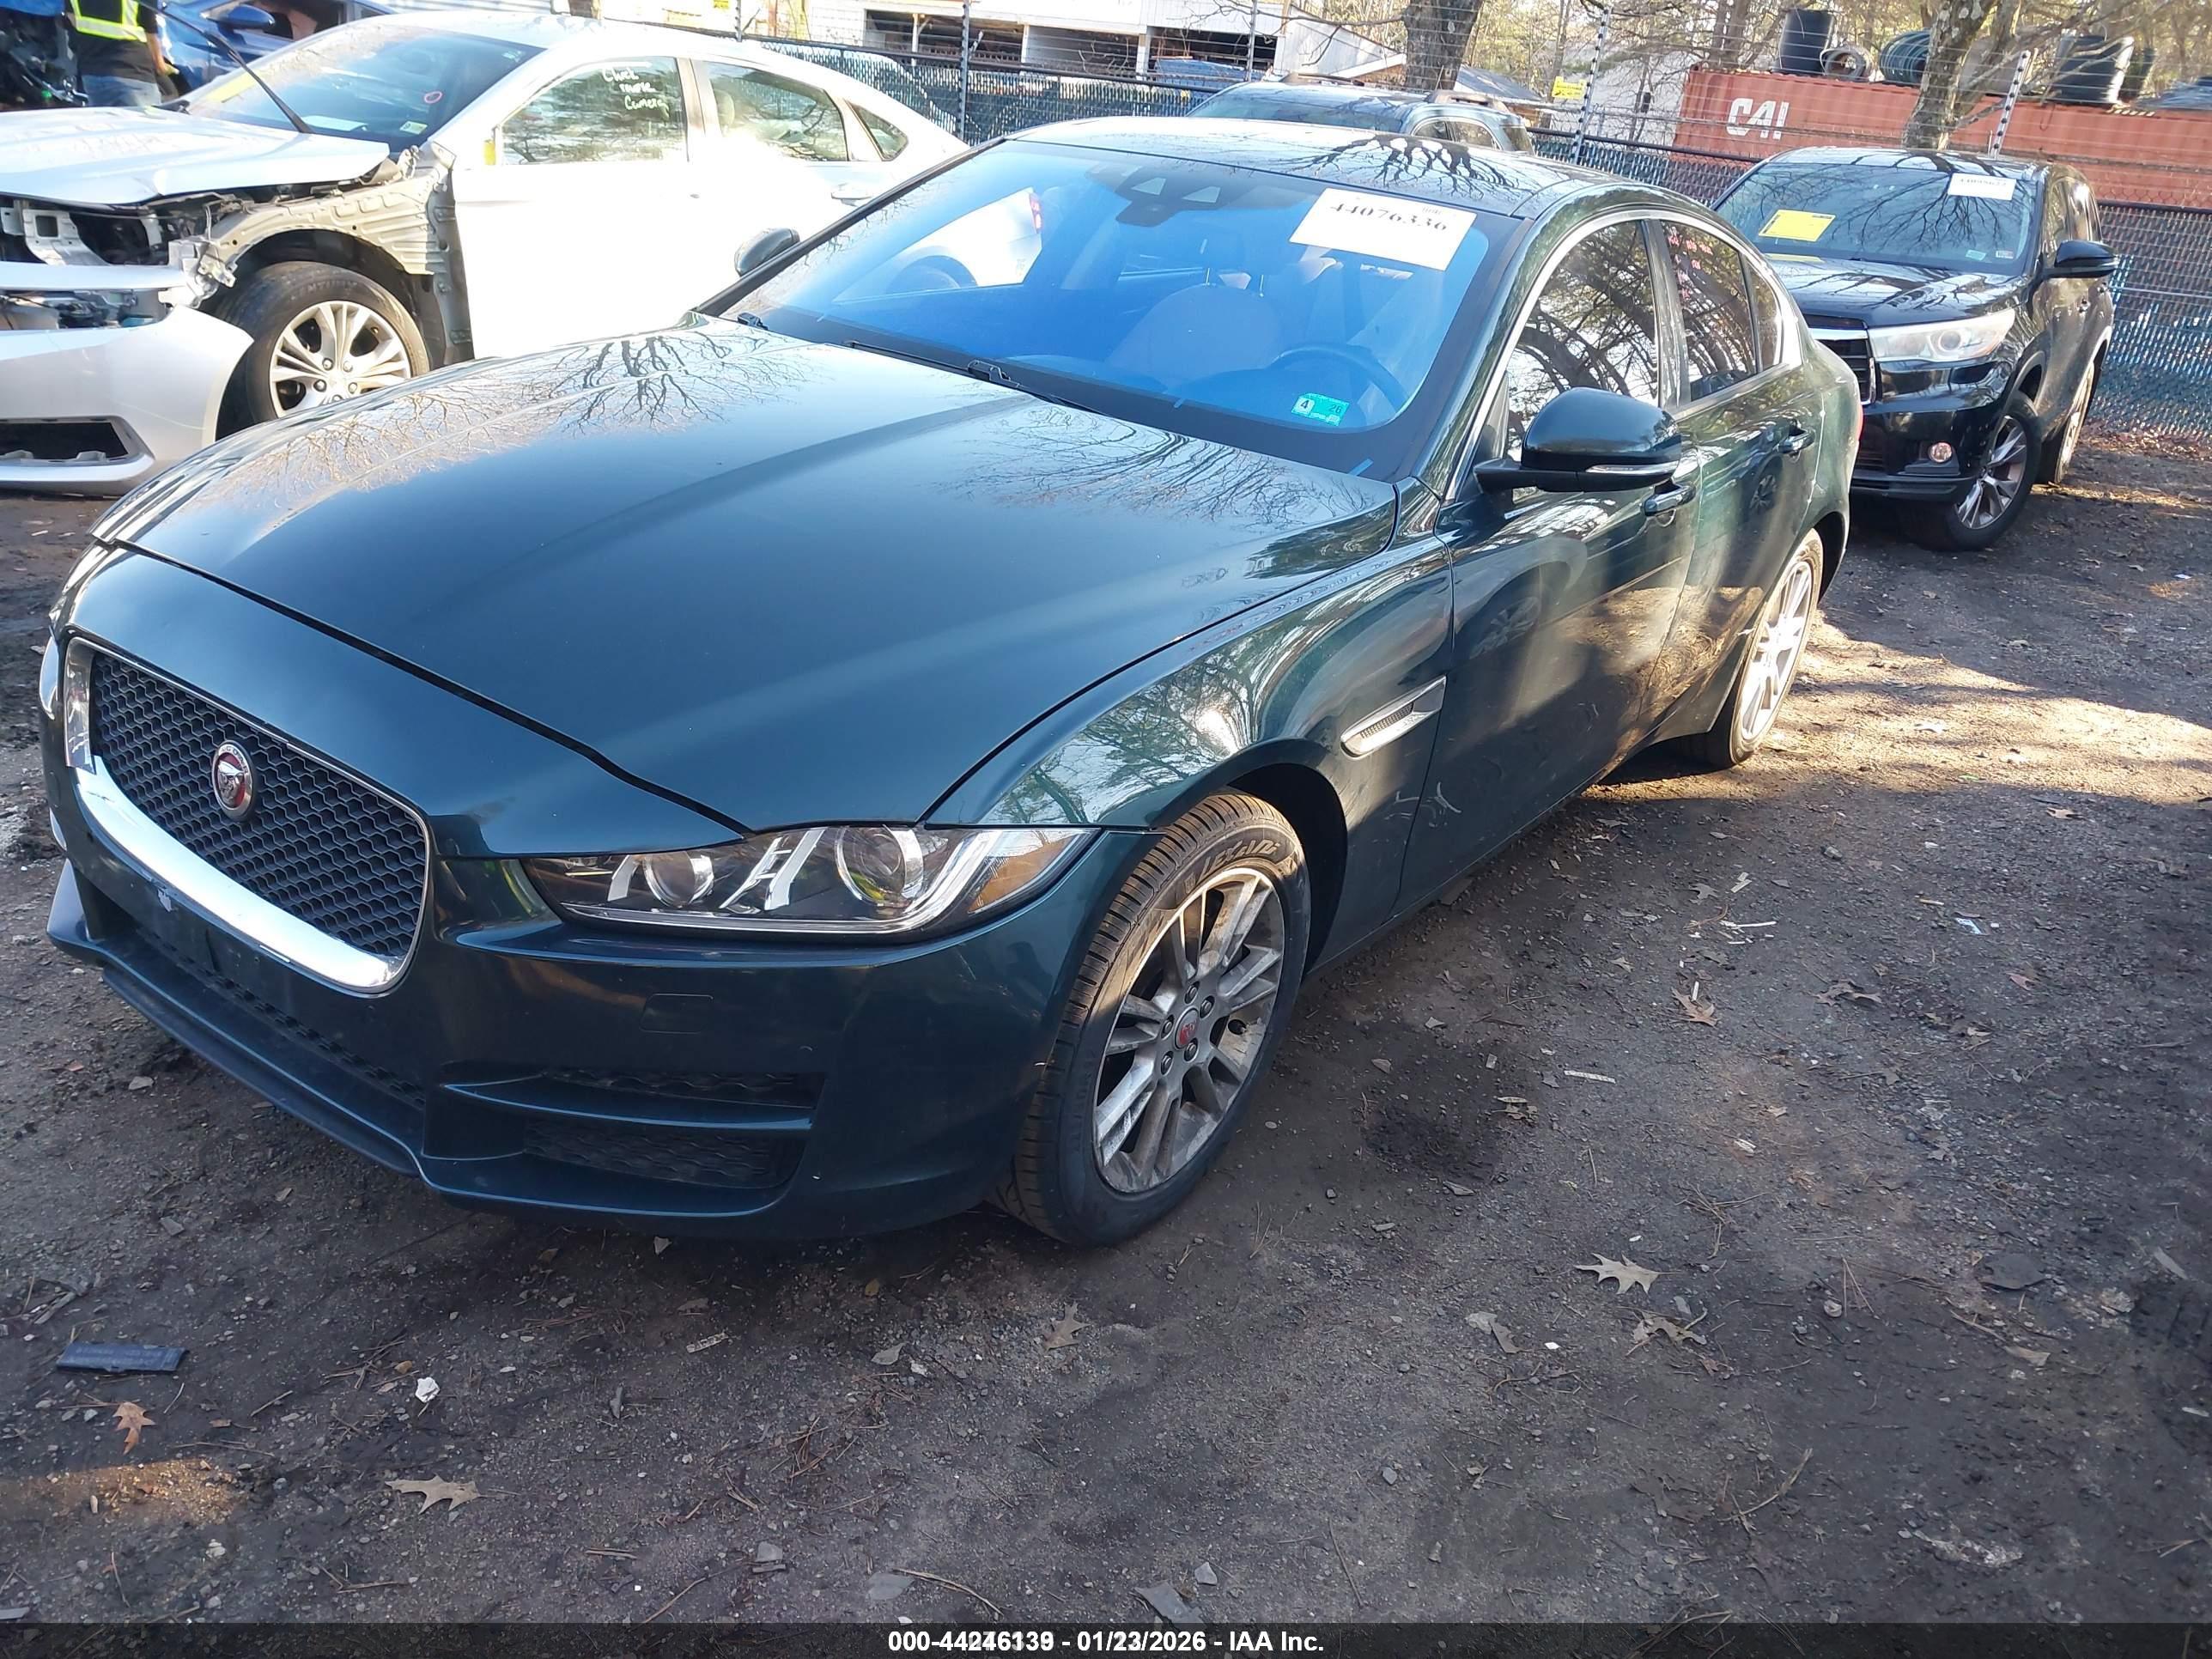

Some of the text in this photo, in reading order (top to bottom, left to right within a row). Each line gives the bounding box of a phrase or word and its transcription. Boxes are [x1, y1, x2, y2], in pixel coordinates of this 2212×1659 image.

[1726, 98, 1790, 140] CAI
[1329, 203, 1448, 231] 44076336
[1300, 399, 1343, 413] 4 26
[219, 745, 248, 774] AGUAR
